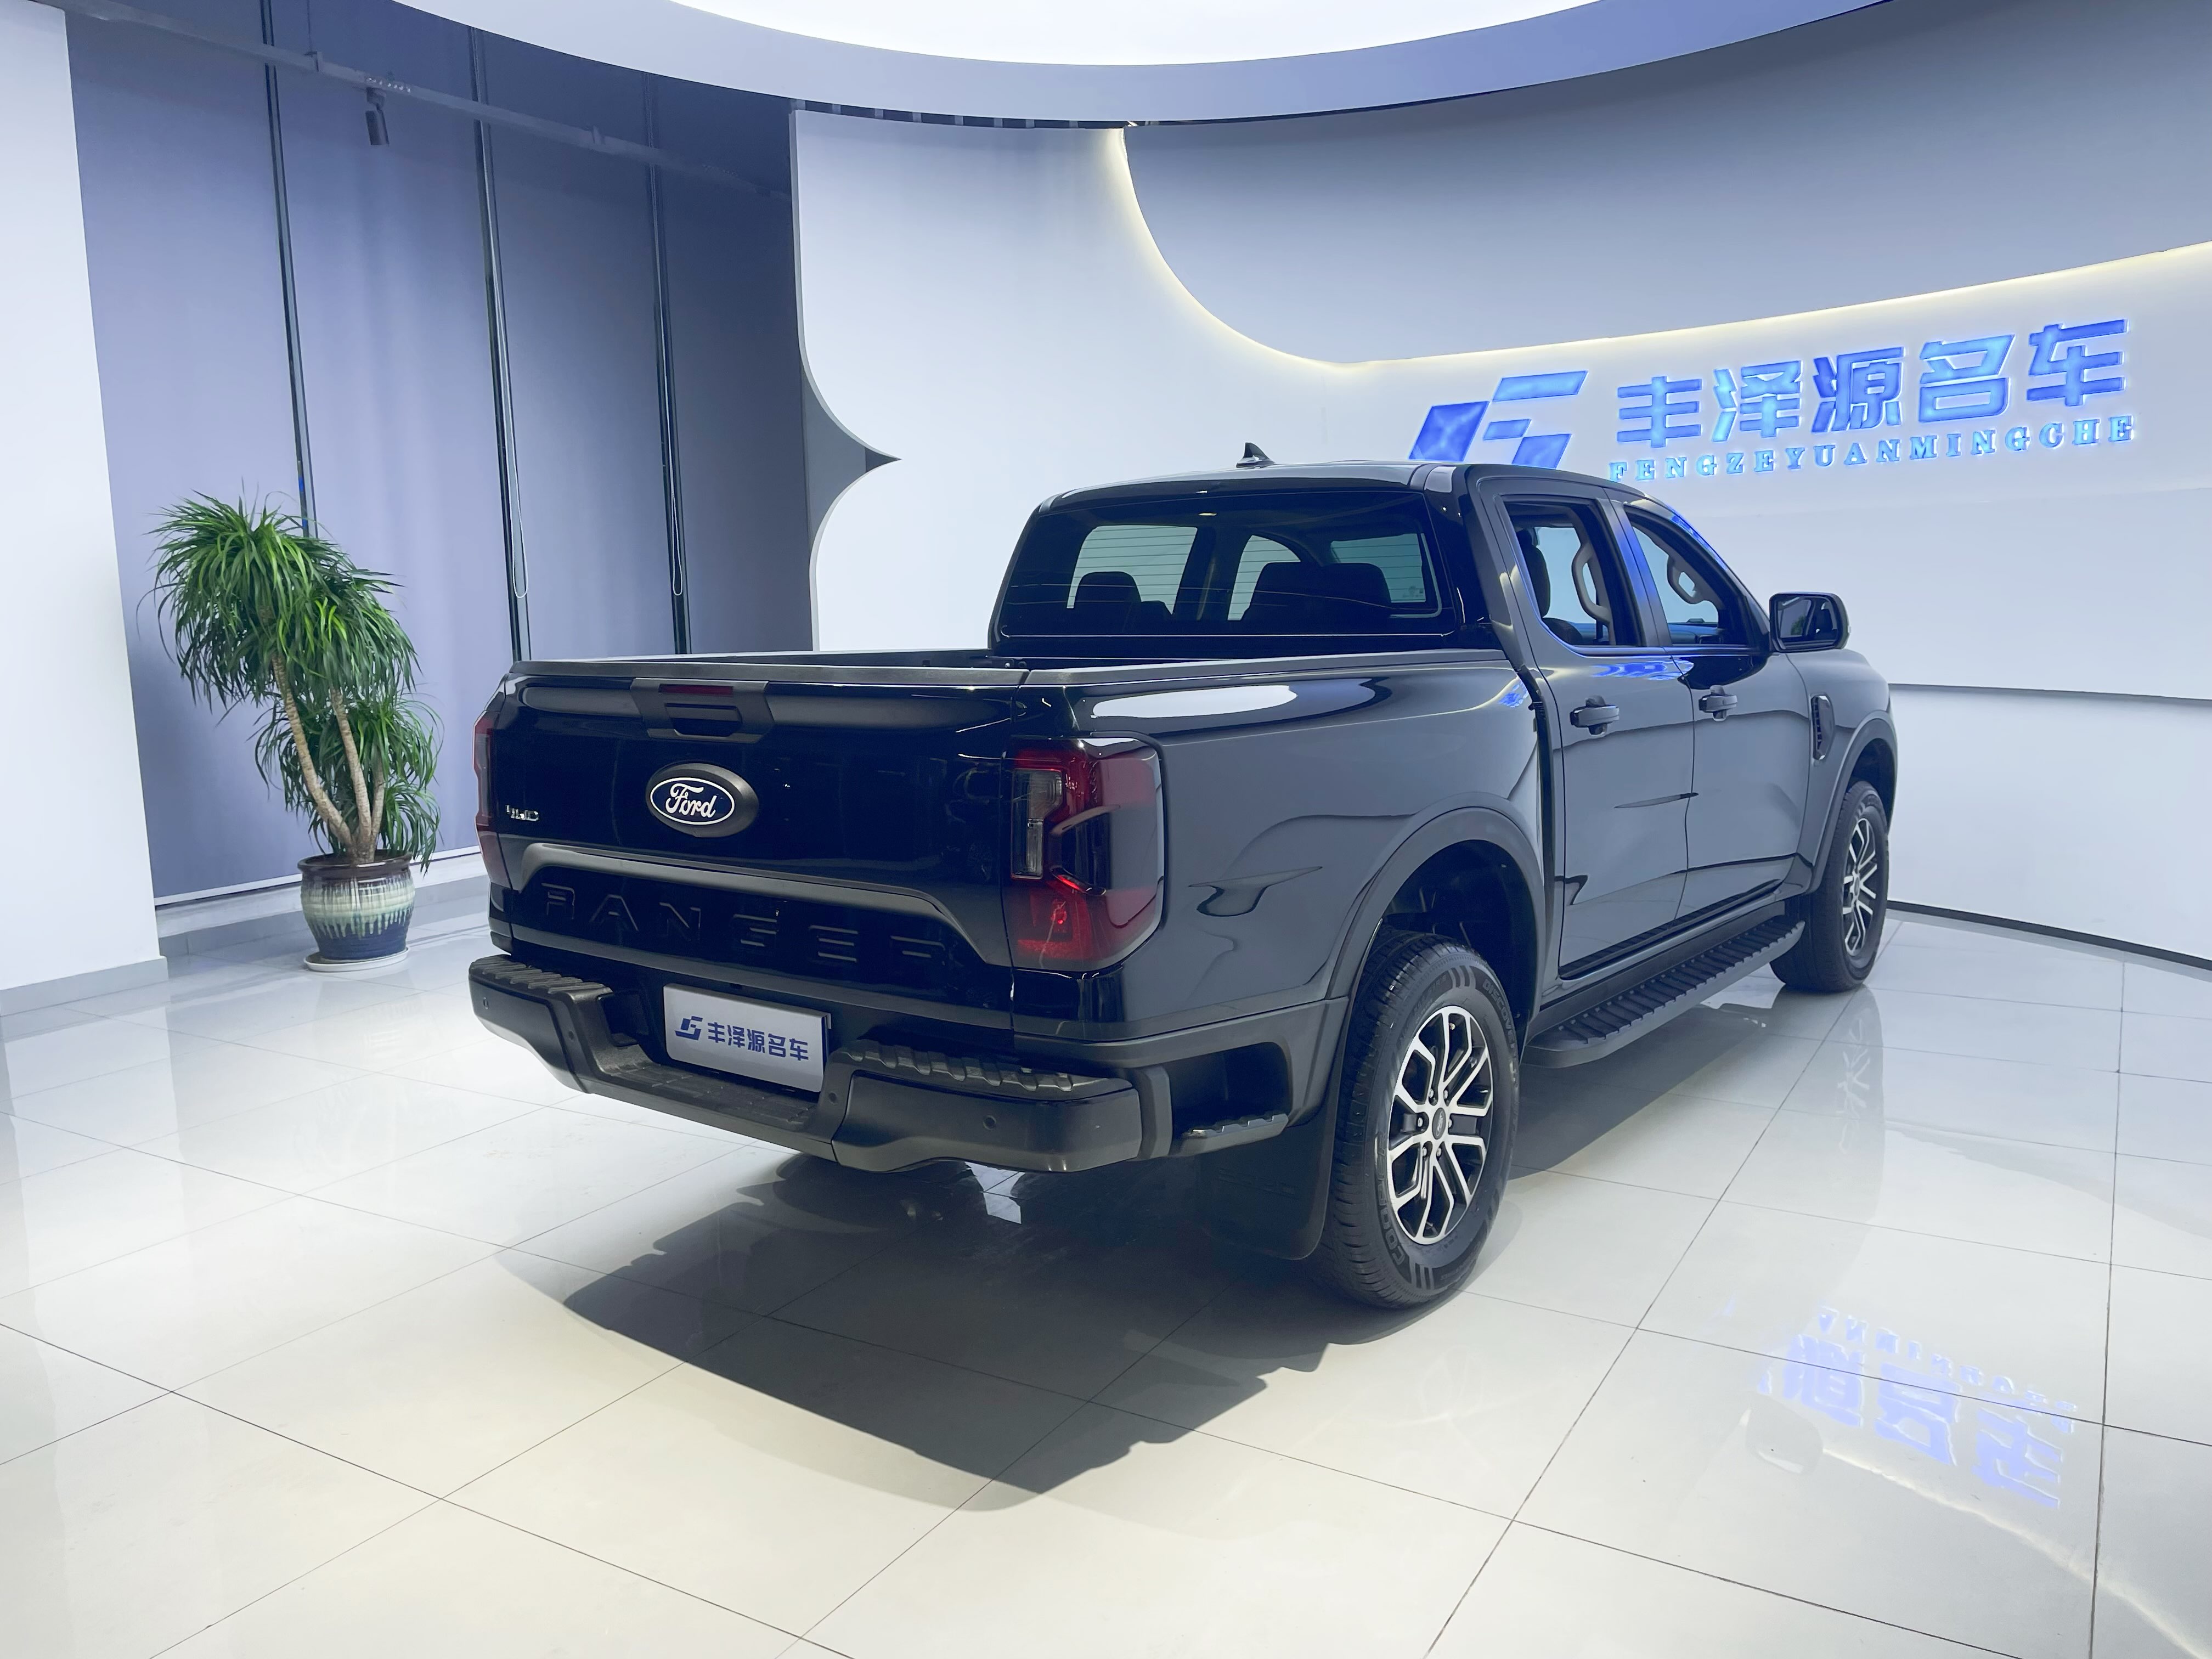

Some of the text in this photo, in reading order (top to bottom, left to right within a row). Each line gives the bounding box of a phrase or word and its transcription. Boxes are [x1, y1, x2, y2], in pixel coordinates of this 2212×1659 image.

[1617, 319, 2128, 447] 丰泽源名车
[1609, 414, 2134, 482] FENGZEYUANMINGCHE
[665, 783, 718, 818] Ford
[707, 1022, 809, 1062] 丰泽源名车
